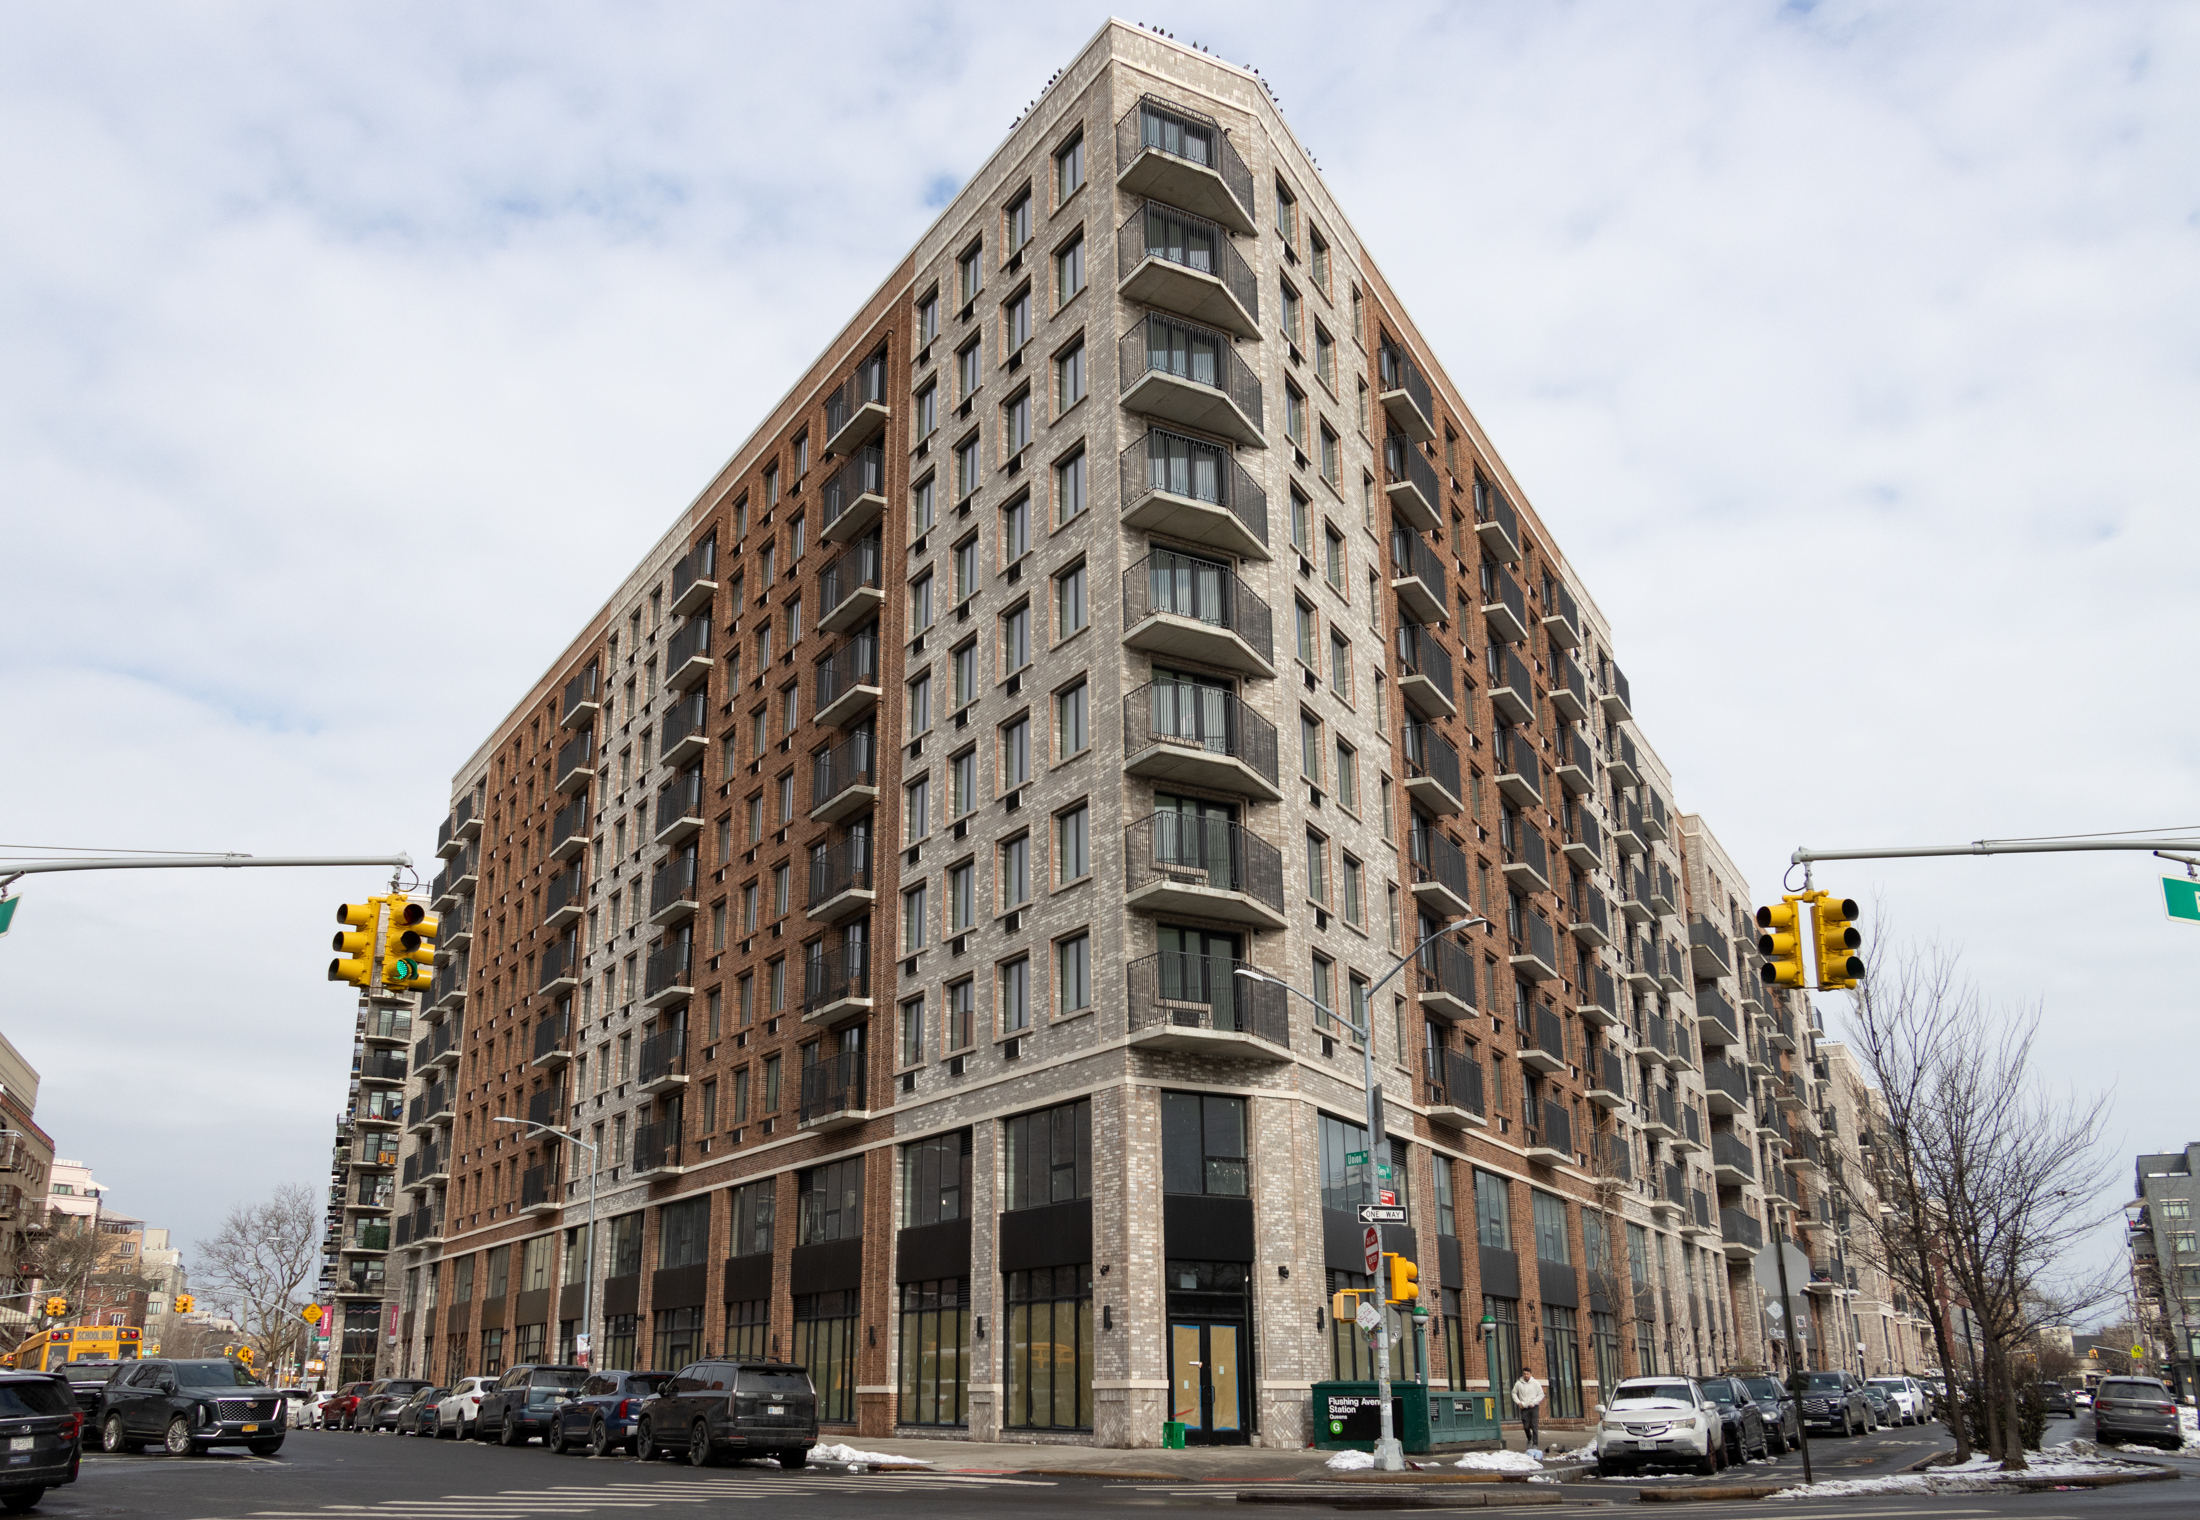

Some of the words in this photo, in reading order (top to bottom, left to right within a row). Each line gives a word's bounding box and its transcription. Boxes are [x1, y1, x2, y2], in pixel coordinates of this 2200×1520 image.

[1348, 1154, 1362, 1164] Union
[1368, 1255, 1377, 1265] ENTER
[77, 1330, 100, 1340] SCHOOL
[101, 1331, 114, 1340] BUS
[1328, 1397, 1359, 1407] Flushing
[1332, 1422, 1341, 1432] G
